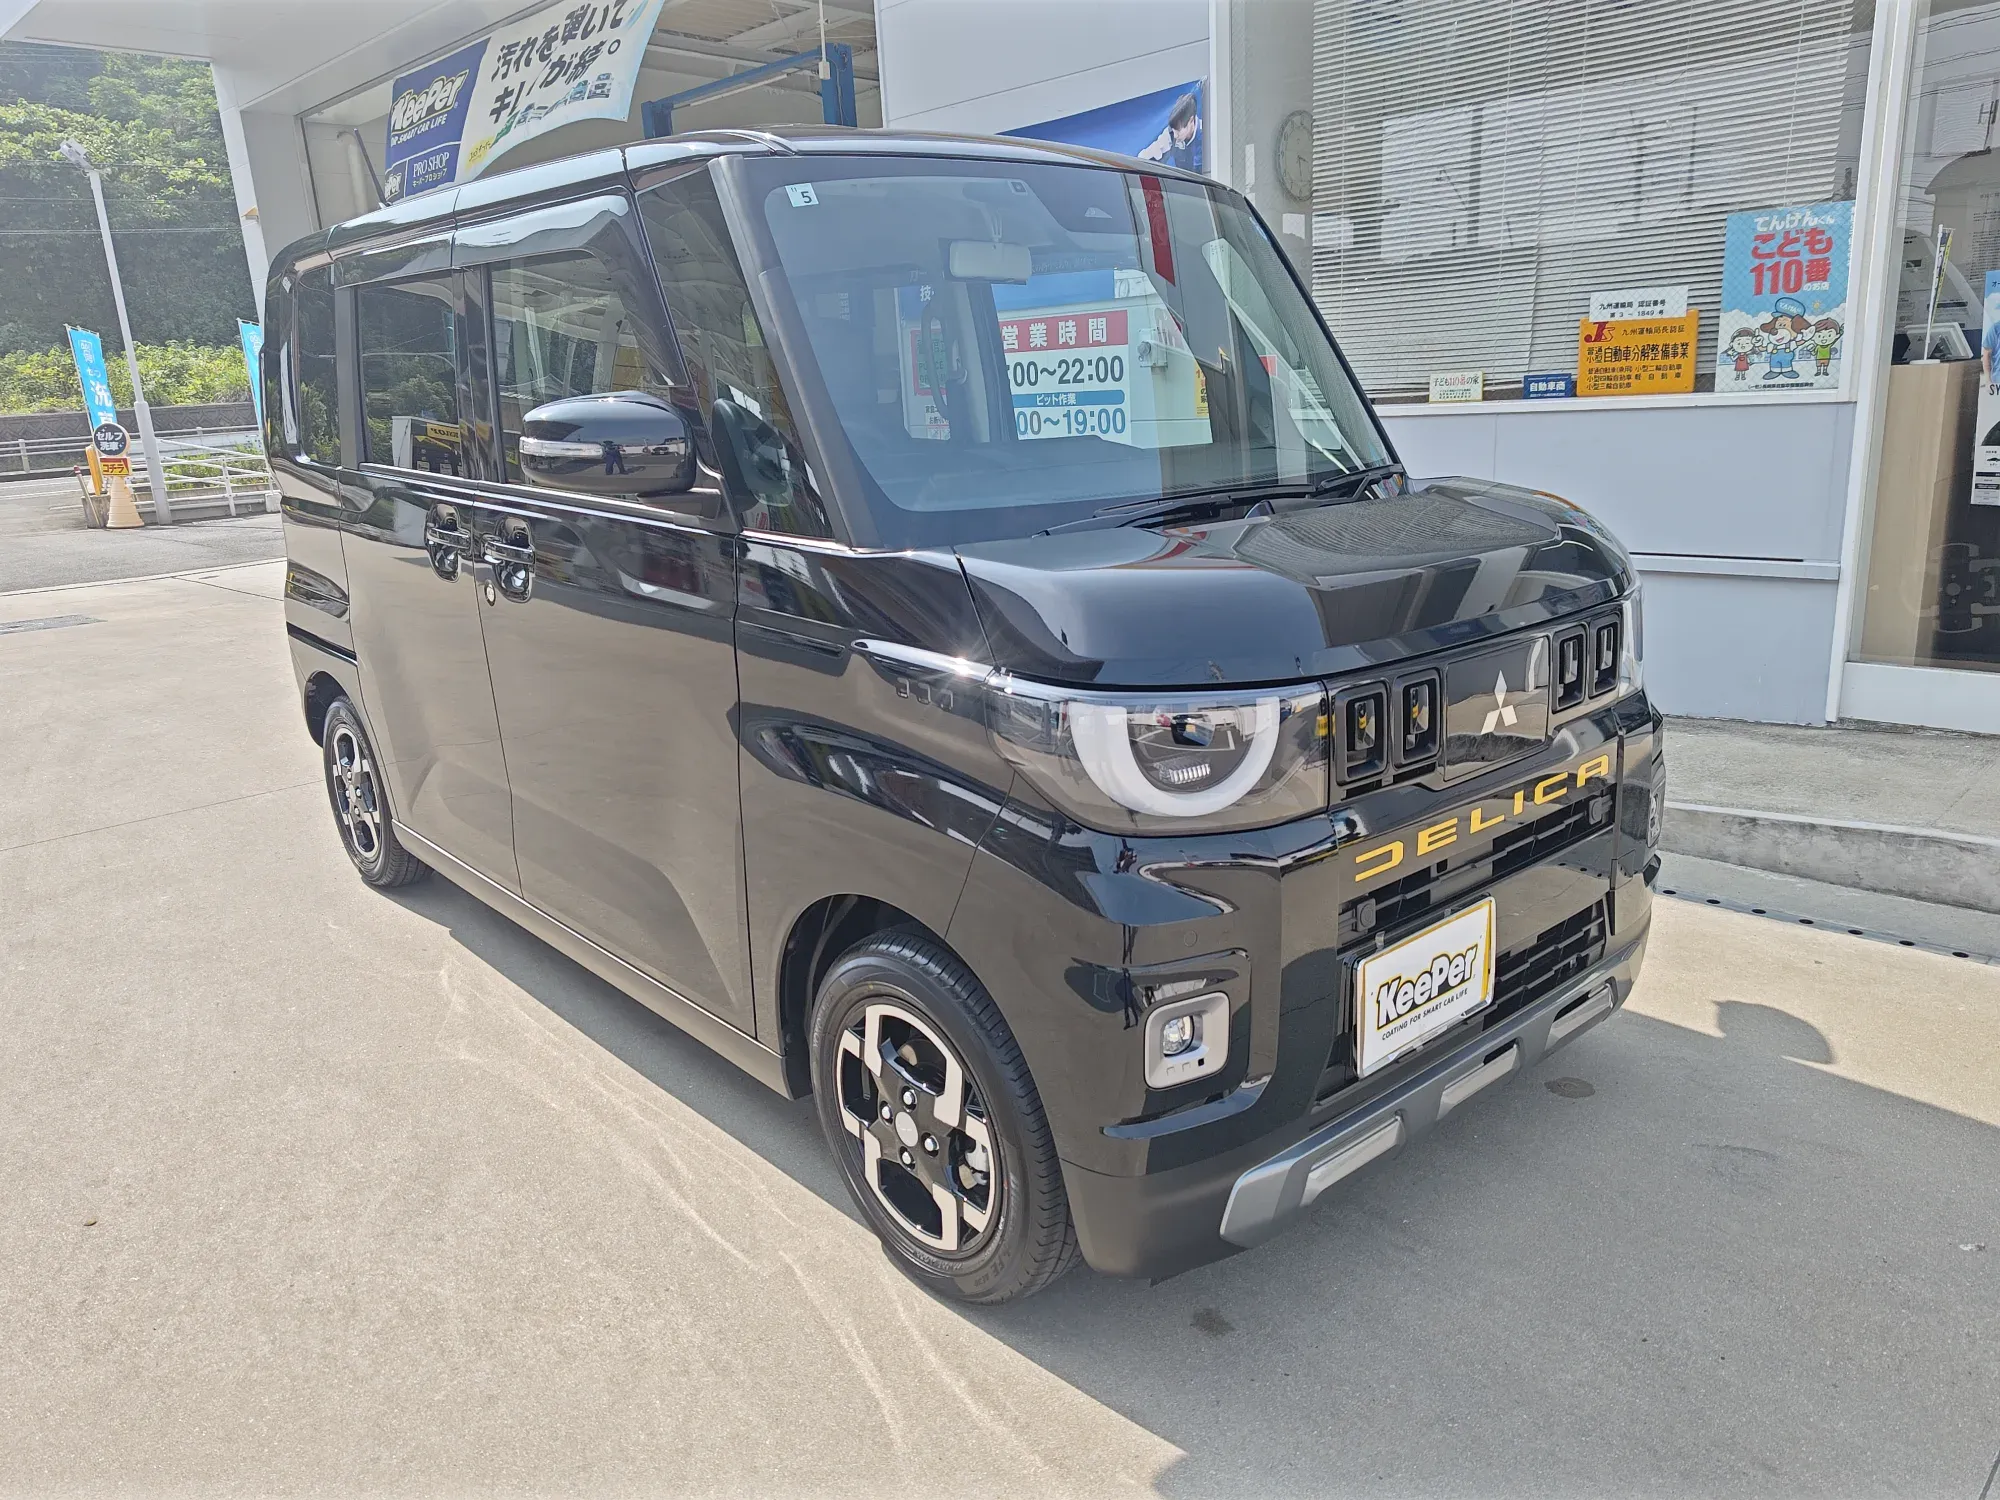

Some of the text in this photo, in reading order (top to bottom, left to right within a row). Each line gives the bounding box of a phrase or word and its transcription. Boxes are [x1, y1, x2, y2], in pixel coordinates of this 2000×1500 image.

[489, 38, 622, 125] キレが続。
[391, 69, 470, 133] KeePer
[417, 120, 431, 135] CAR
[431, 113, 448, 129] LIFE
[413, 151, 450, 177] PRO SHOP
[800, 191, 812, 204] 5
[1754, 209, 1835, 232] てんけんくん
[1751, 227, 1834, 260] こども
[1750, 257, 1832, 297] 110番
[1803, 281, 1830, 292] のお店
[1001, 316, 1108, 350] 営業時間
[1603, 341, 1690, 363] 自動車分解整備事業
[1036, 392, 1077, 406] ピット作業
[95, 431, 123, 441] セルフ
[102, 463, 125, 474] コチラ
[1355, 754, 1610, 883] DELICA
[1376, 943, 1478, 1031] KeePer
[1382, 987, 1468, 1041] COATING FOR SMART CAR LIFE
